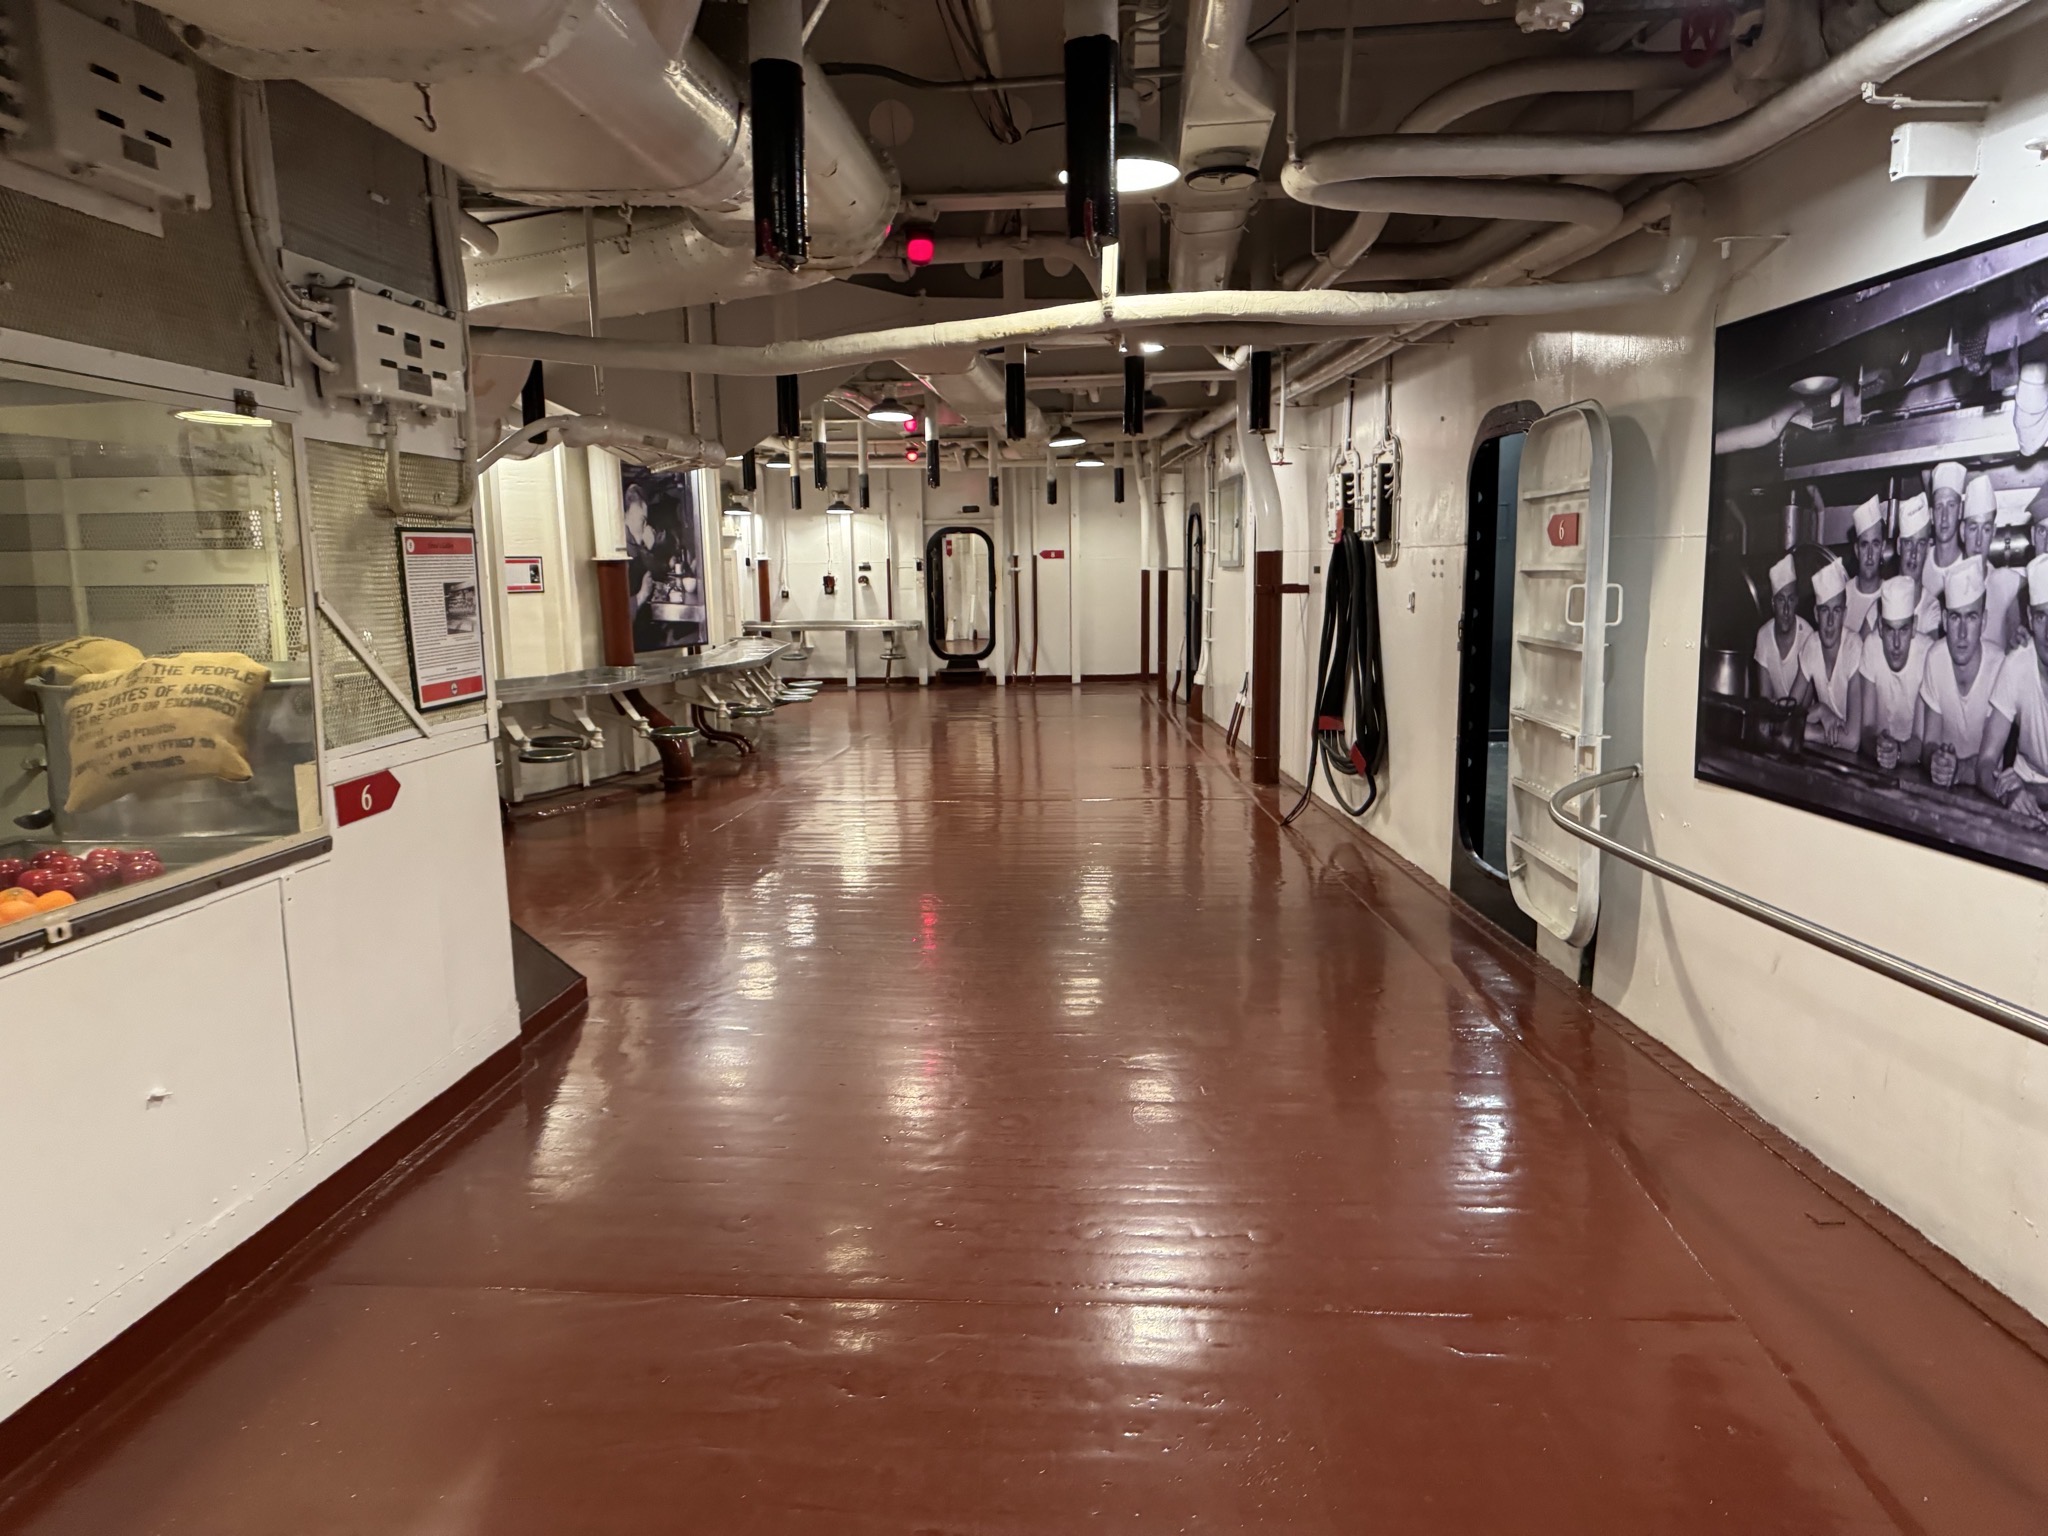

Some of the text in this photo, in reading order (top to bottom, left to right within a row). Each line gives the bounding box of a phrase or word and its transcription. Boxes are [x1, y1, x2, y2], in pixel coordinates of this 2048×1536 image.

[1558, 519, 1565, 541] 6
[152, 663, 184, 676] THE
[191, 665, 257, 685] PEOPLE
[97, 686, 149, 711] STATES
[155, 684, 178, 698] OF
[181, 683, 246, 708] AMERICA
[109, 703, 139, 720] SOLD
[361, 783, 373, 811] 6
